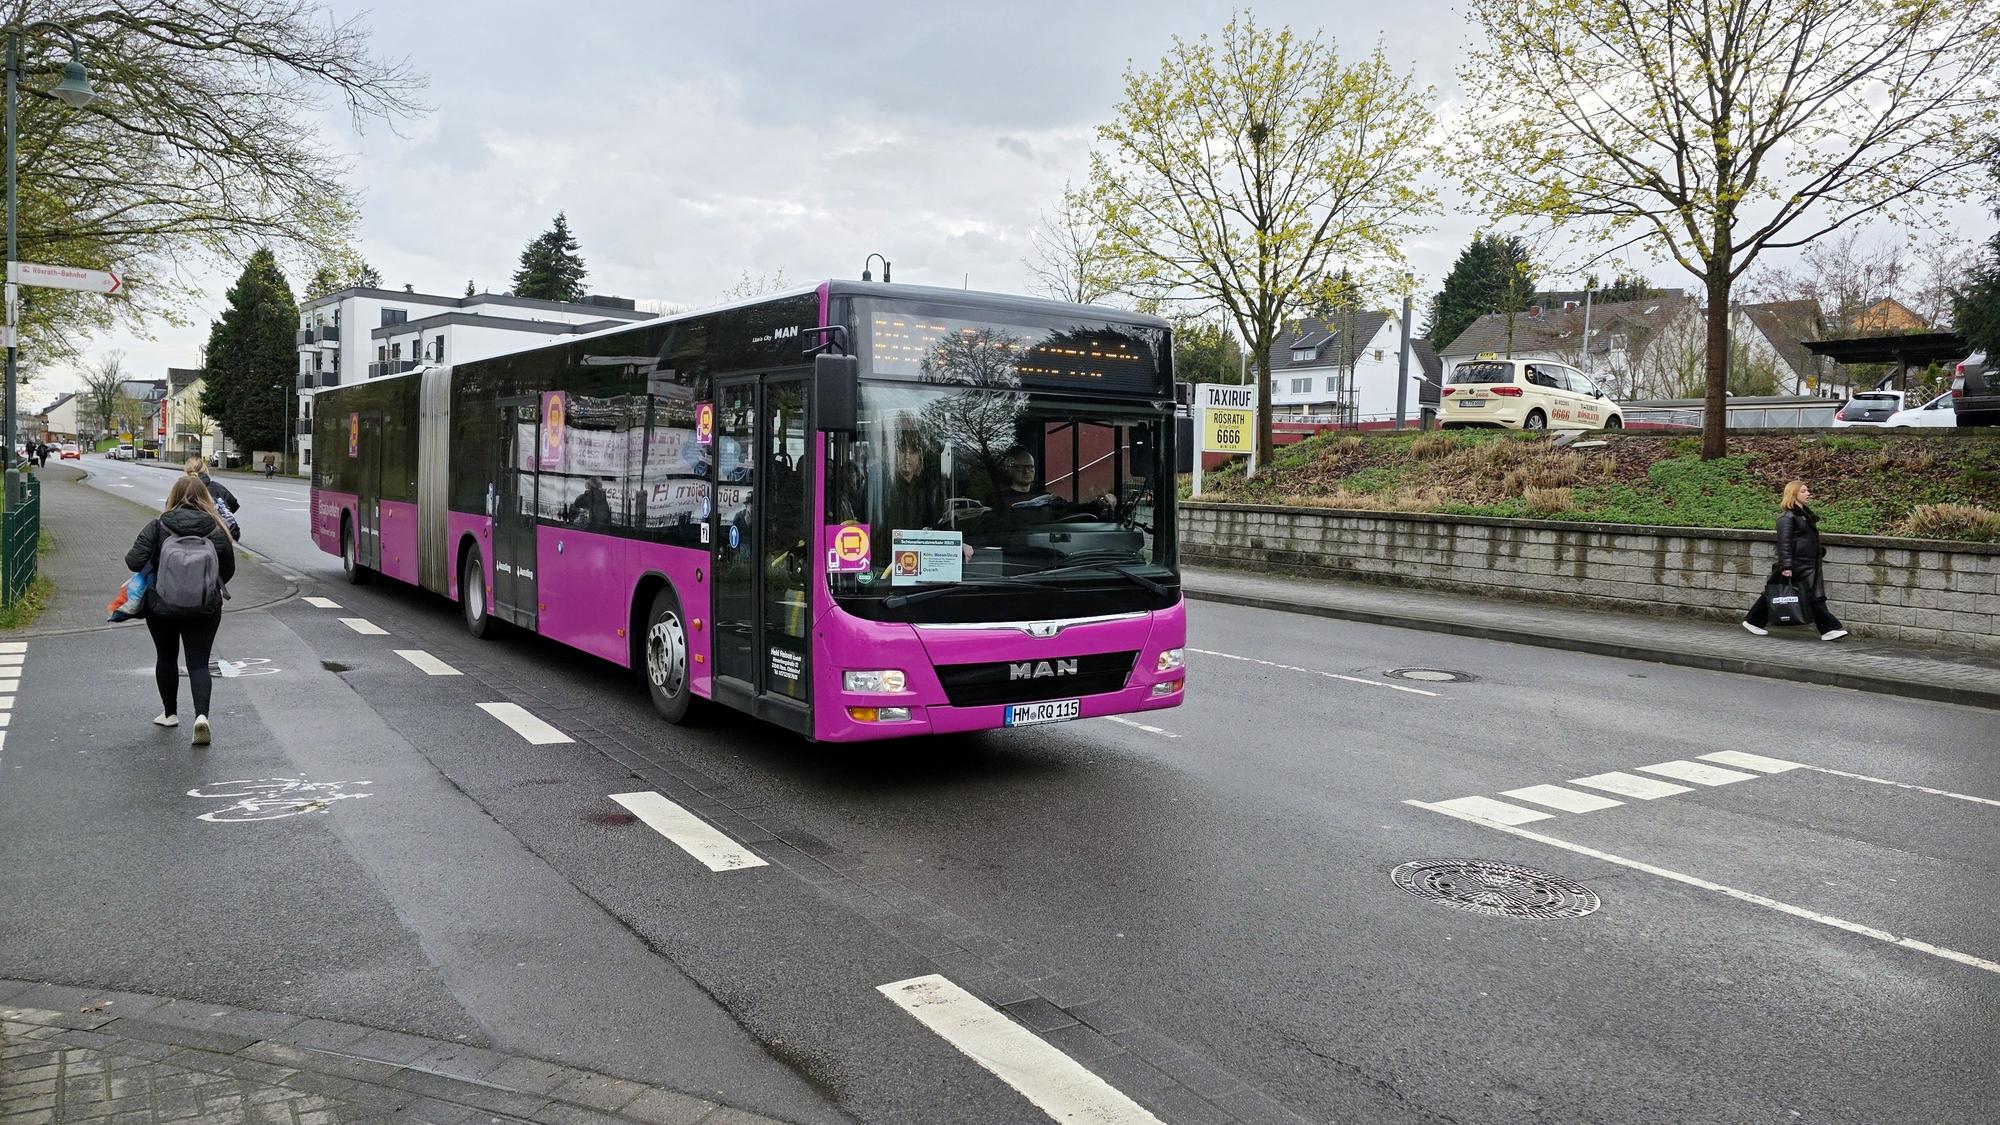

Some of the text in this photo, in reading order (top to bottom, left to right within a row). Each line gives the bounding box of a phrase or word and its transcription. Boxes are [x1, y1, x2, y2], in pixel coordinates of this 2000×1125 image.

[774, 326, 798, 339] MAN
[1209, 389, 1251, 406] TAXIRUF
[1214, 411, 1245, 424] RÖSRATH
[1551, 408, 1571, 421] 6666
[1217, 429, 1240, 444] 6666
[1009, 659, 1078, 680] MAN
[1013, 702, 1078, 722] HM RQ 115
